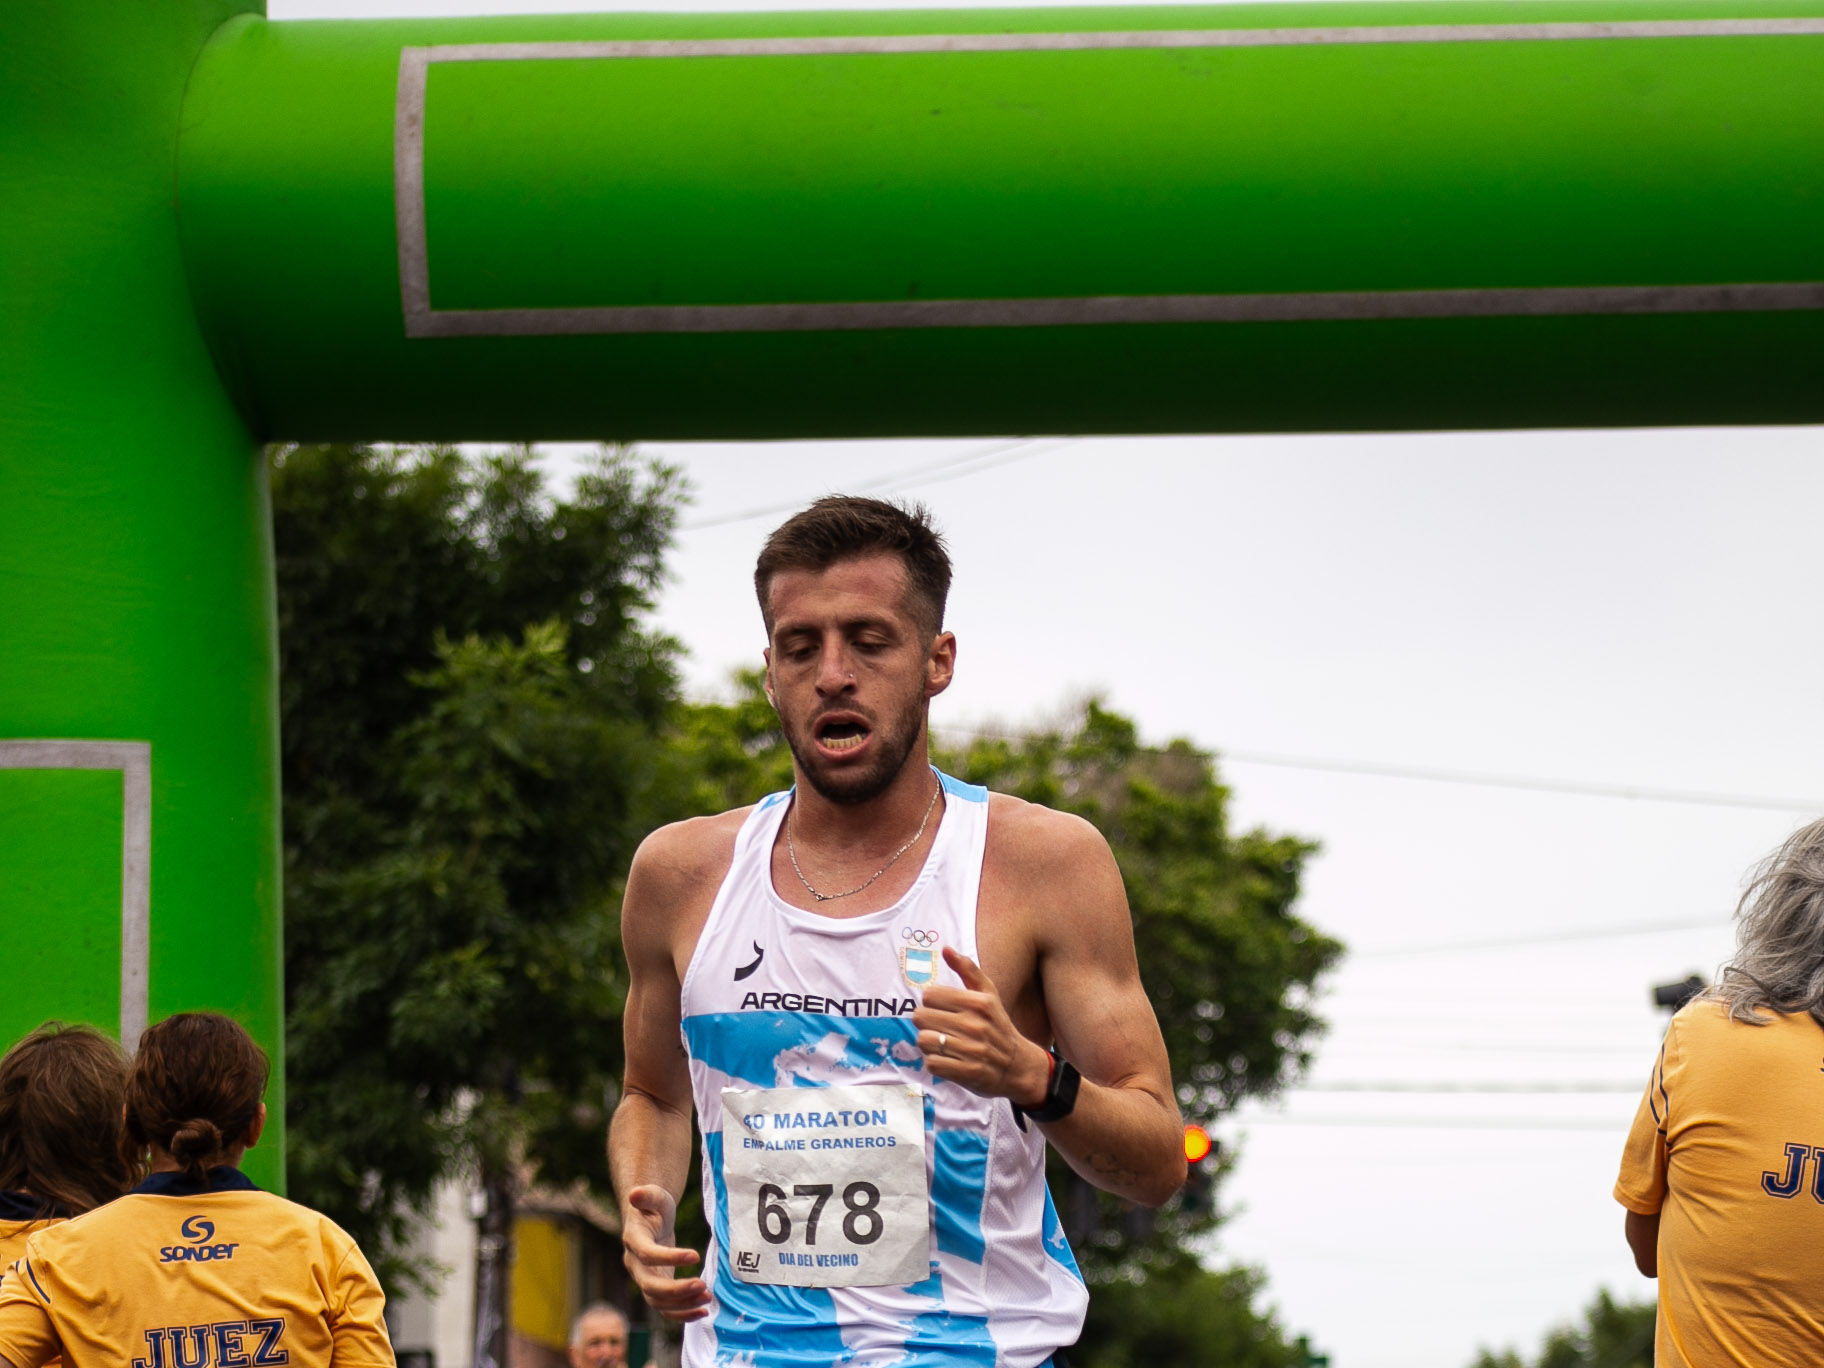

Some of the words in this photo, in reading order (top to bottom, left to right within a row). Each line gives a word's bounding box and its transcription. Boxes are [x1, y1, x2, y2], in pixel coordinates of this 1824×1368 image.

[740, 992, 918, 1017] ARGENTINA
[774, 1109, 887, 1129] MARATON
[743, 1138, 806, 1151] EMPALME
[811, 1136, 897, 1150] GRANEROS
[757, 1181, 884, 1246] 678
[736, 1251, 761, 1269] NEJ
[778, 1252, 796, 1266] DIA
[797, 1253, 814, 1267] DEL
[816, 1253, 859, 1267] VECINO
